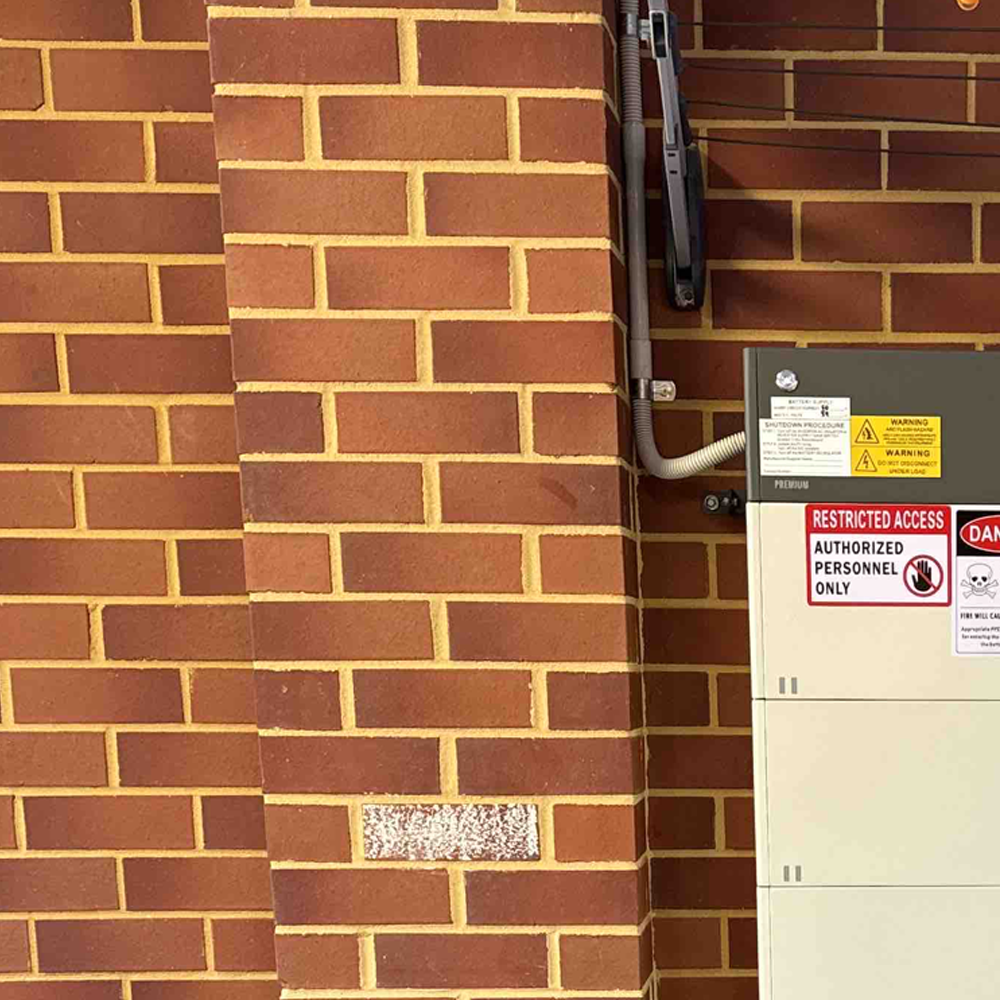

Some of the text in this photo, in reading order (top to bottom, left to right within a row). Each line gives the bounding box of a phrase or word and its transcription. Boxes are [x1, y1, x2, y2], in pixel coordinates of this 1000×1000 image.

[891, 418, 929, 426] WARNING
[886, 449, 931, 457] WARNING
[774, 479, 809, 489] PREMIUM
[812, 509, 945, 530] RESTRICTED ACCESS
[814, 540, 904, 555] AUTHORIZED
[814, 561, 899, 575] PERSONNEL
[815, 581, 851, 596] ONLY
[960, 612, 973, 620] FIRE
[974, 612, 988, 620] WILL
